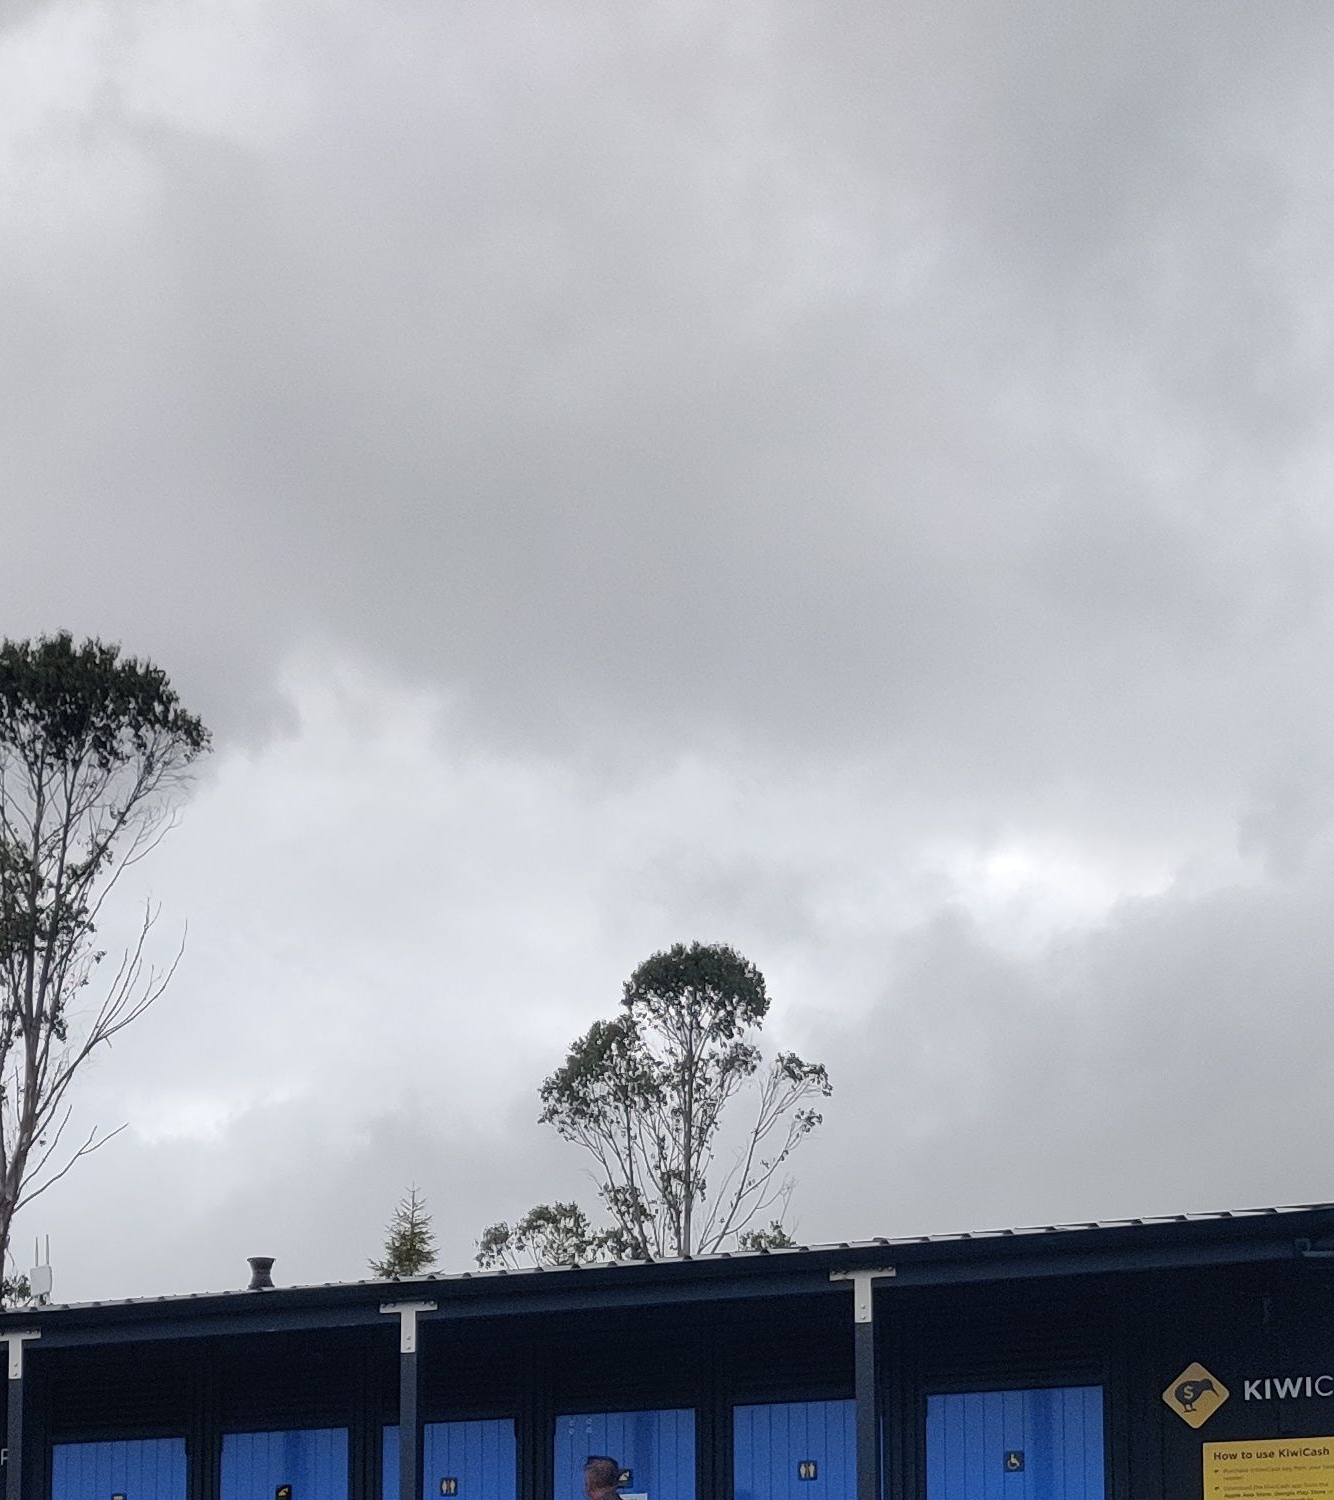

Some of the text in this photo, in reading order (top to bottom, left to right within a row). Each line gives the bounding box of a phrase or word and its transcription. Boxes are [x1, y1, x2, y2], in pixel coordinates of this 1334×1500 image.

[1213, 1446, 1330, 1461] How to use KiwiCash
